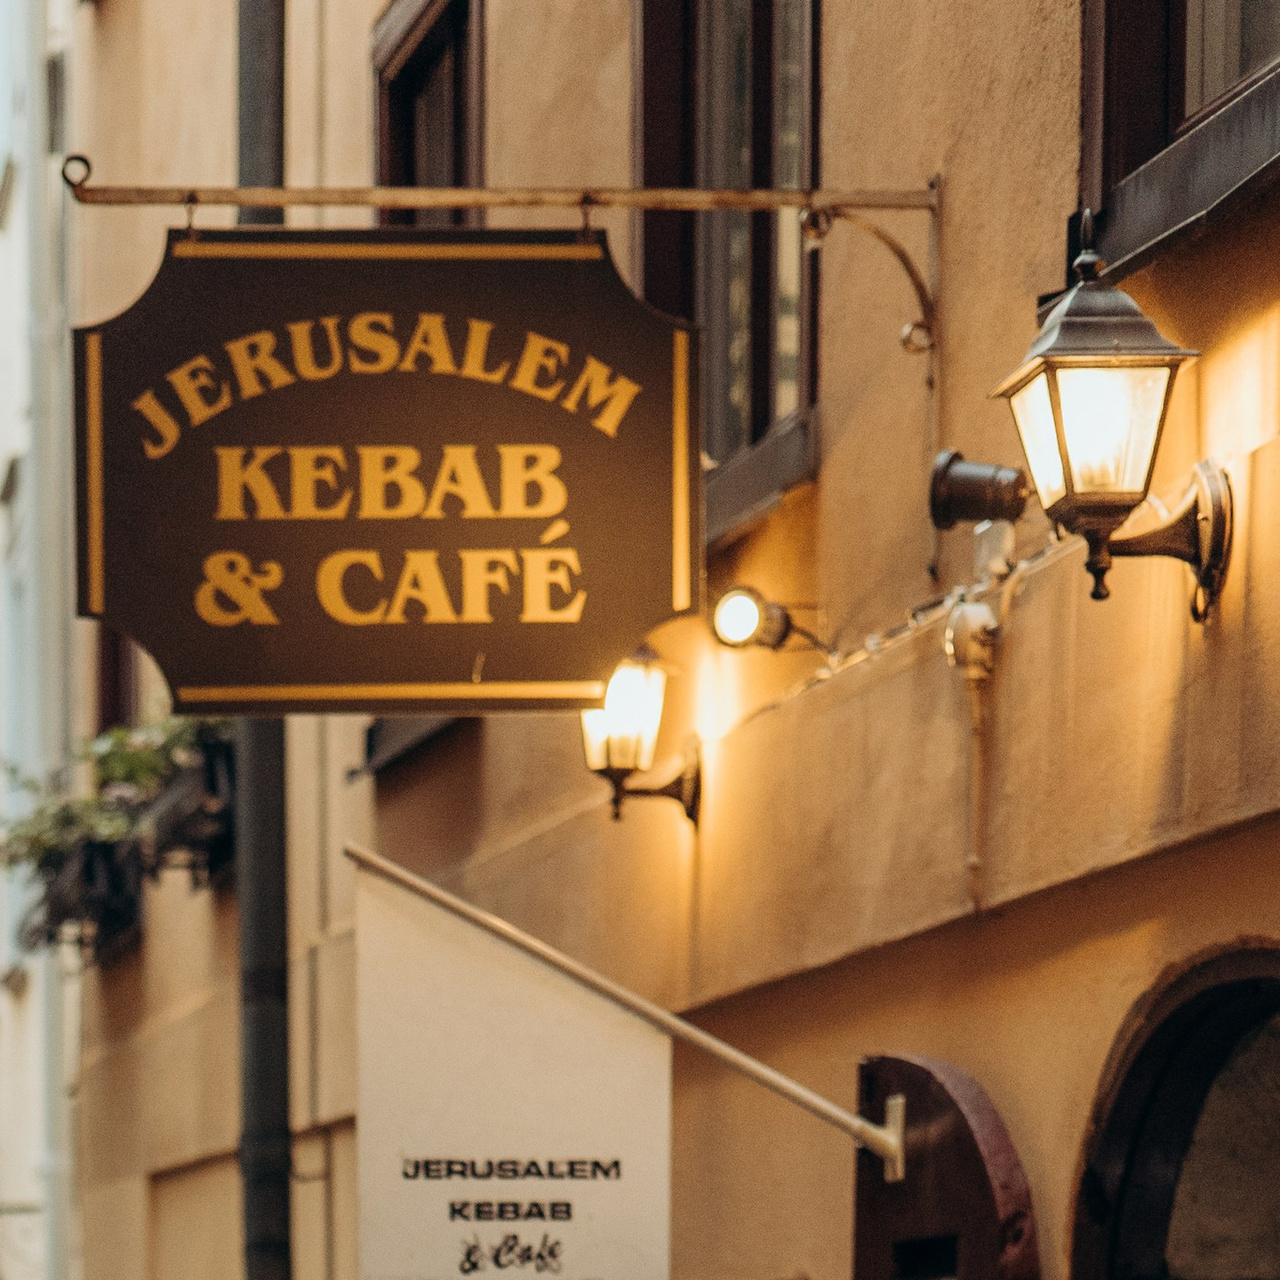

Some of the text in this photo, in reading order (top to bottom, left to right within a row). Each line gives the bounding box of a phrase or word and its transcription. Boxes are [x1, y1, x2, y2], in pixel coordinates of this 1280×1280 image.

[131, 311, 643, 460] JERUSALEM
[214, 443, 569, 520] KEBAB
[193, 519, 588, 627] & CAFÉ
[402, 1160, 621, 1180] JERUSALEM
[448, 1201, 572, 1222] KEBAB
